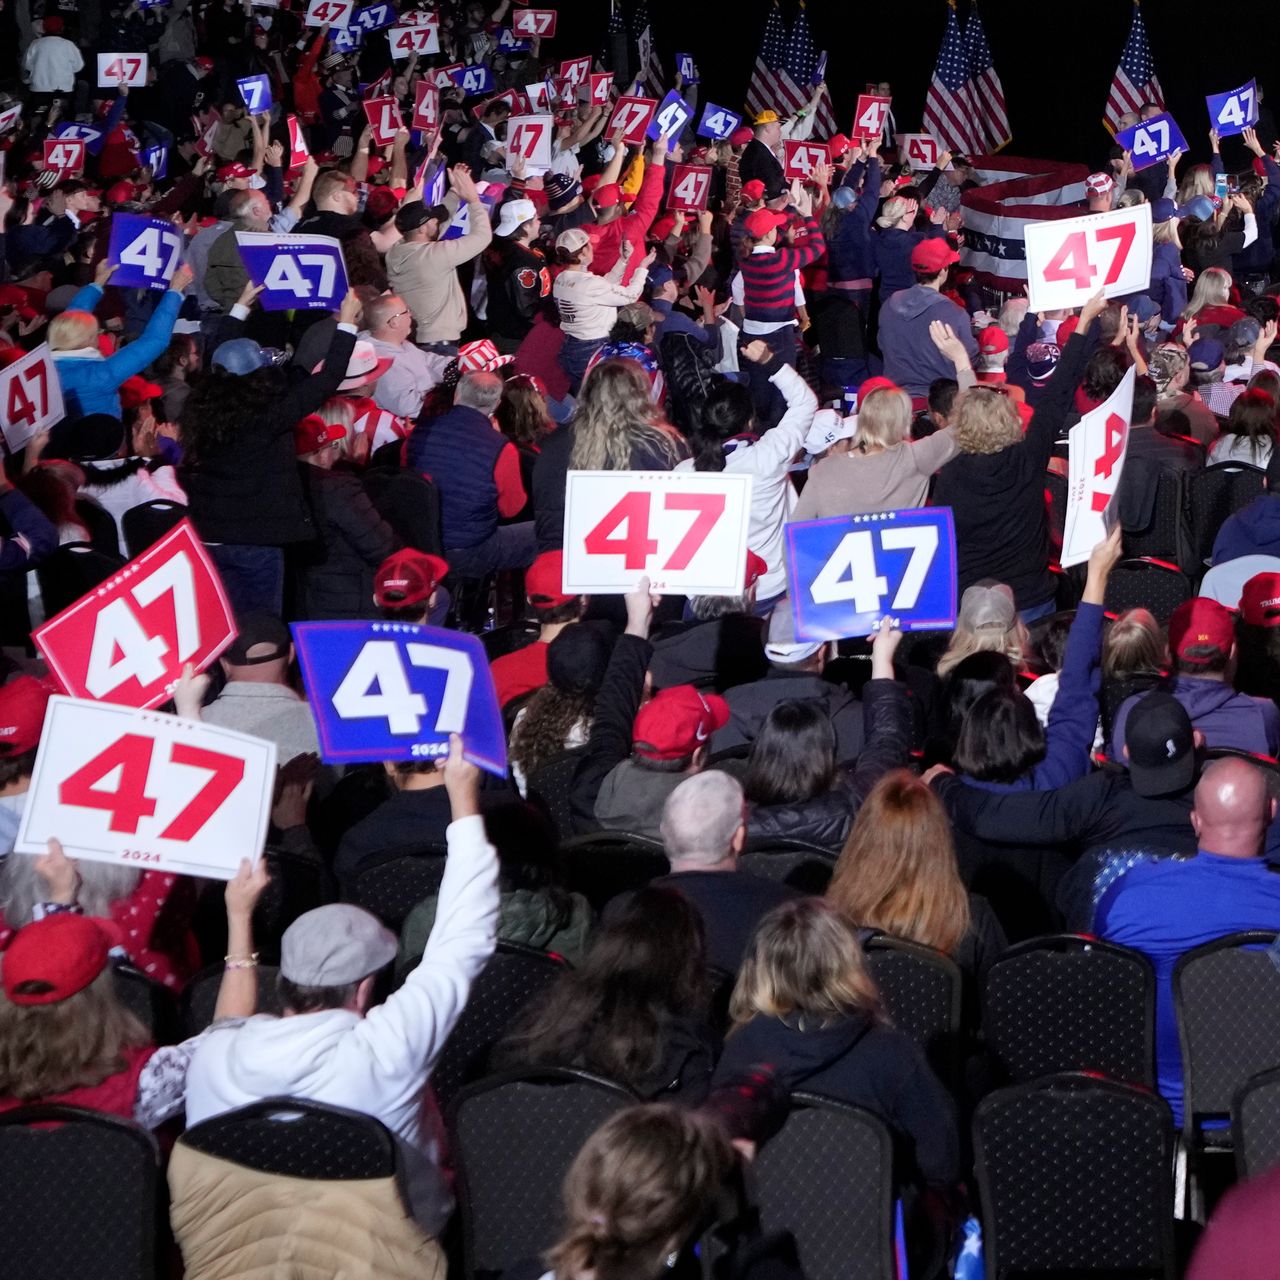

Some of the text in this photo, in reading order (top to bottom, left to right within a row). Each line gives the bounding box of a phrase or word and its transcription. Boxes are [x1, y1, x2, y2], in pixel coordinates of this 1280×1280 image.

[396, 29, 430, 50] 47
[518, 10, 552, 34] 47
[105, 59, 141, 82] 47
[657, 101, 687, 139] 47
[706, 112, 738, 134] 47
[1218, 88, 1253, 126] 47
[48, 144, 80, 167] 47
[510, 124, 543, 158] 47
[1133, 120, 1169, 156] 47
[120, 228, 182, 280] 47
[1043, 222, 1136, 288] 47
[264, 254, 336, 298] 47
[8, 359, 48, 426] 47
[584, 492, 725, 570] 47
[809, 526, 938, 613] 47
[86, 551, 200, 698] 47
[332, 641, 473, 734] 47
[411, 742, 448, 756] 2024
[60, 733, 245, 841] 47
[122, 849, 160, 862] 2024
